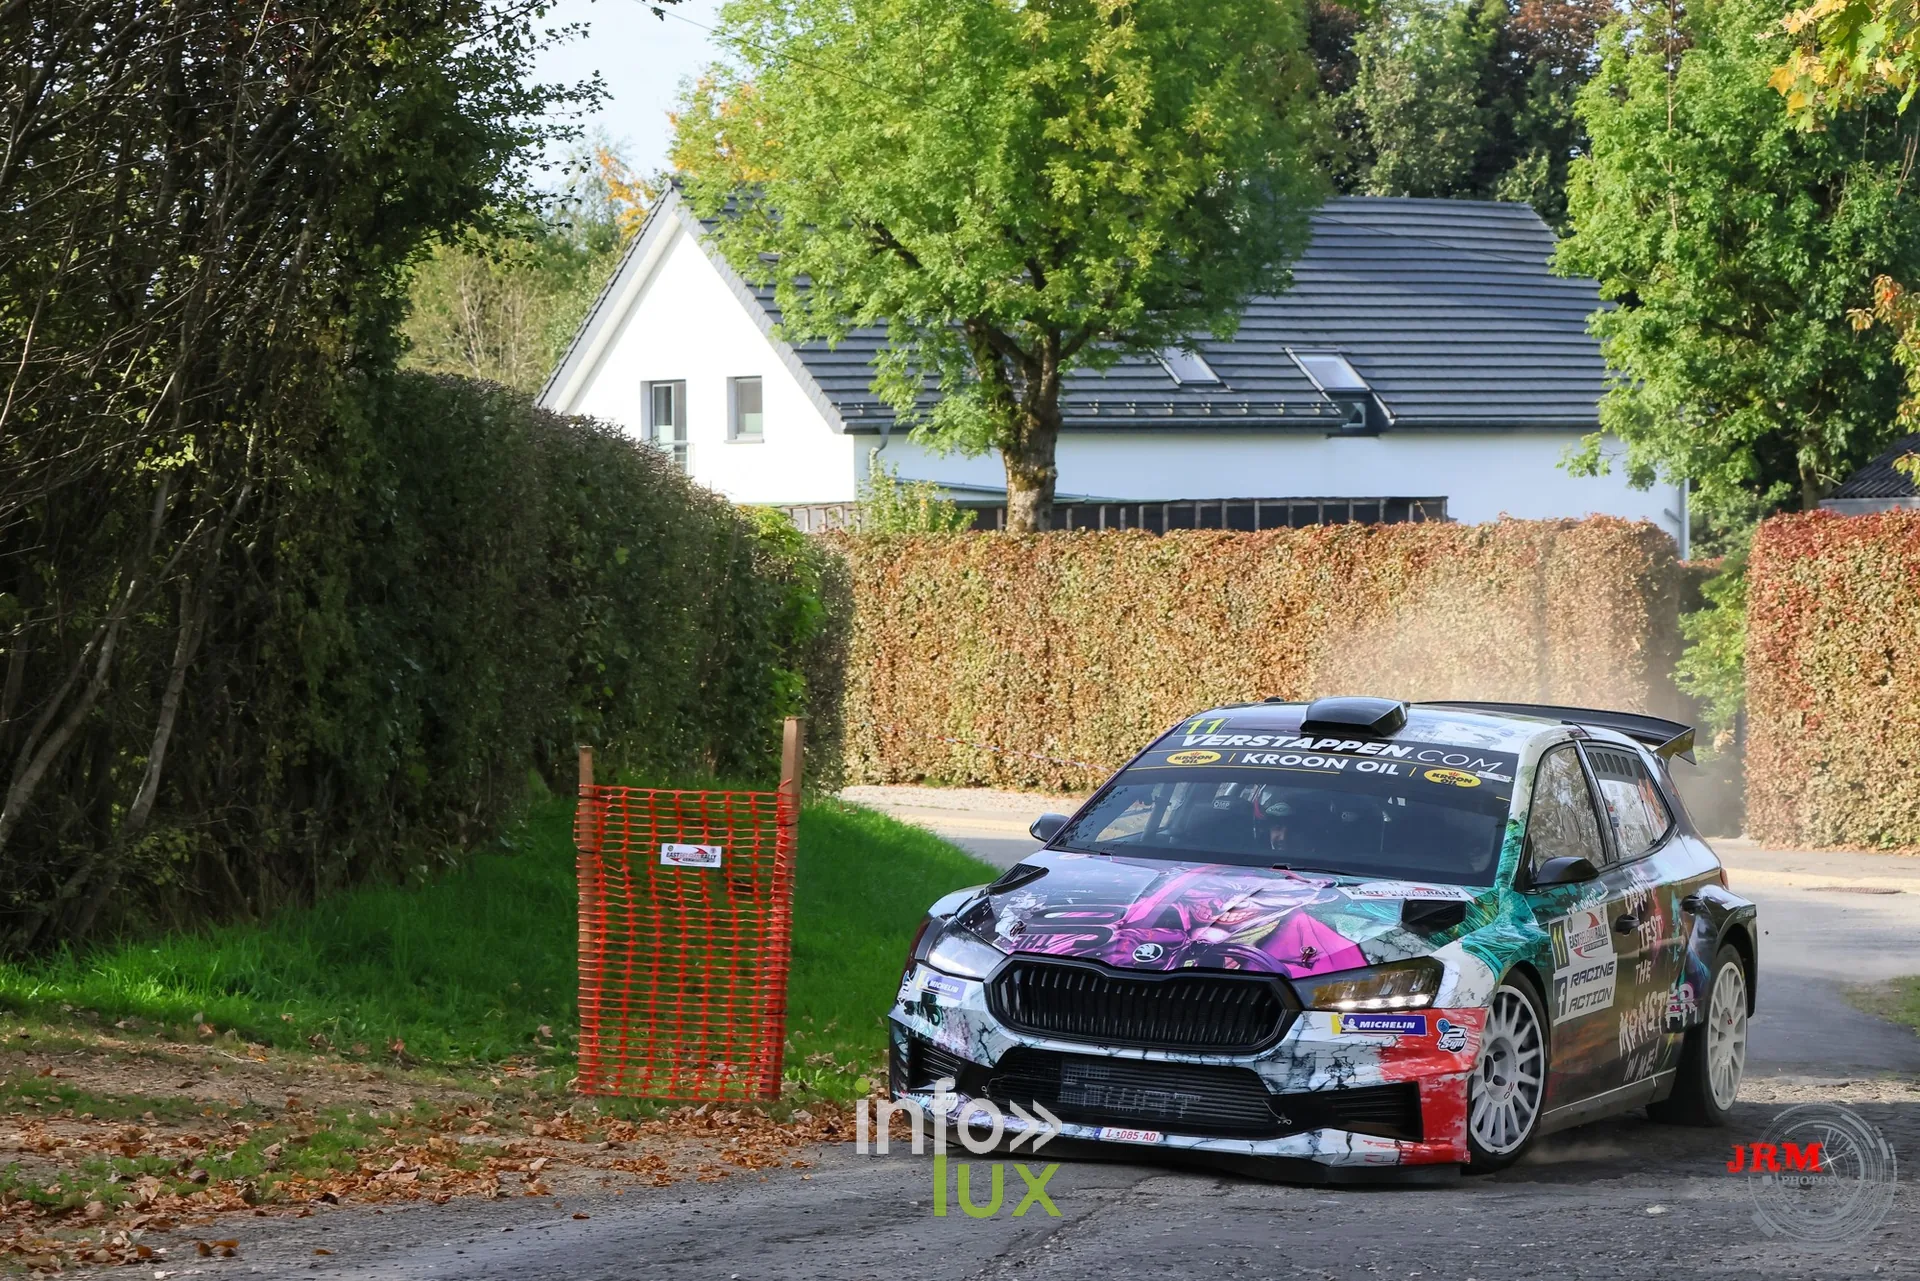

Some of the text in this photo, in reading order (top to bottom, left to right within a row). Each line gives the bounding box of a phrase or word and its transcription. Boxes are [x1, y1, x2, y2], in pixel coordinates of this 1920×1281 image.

[1186, 719, 1225, 734] 11
[1181, 734, 1503, 772] VERSTAPPEN.COM
[1241, 753, 1400, 776] KROON OIL
[1431, 772, 1473, 784] KROON
[1553, 925, 1567, 966] 11
[1638, 915, 1662, 951] TEST
[1570, 961, 1614, 986] RACING
[1635, 959, 1651, 985] THE
[929, 980, 959, 992] MICHELIN
[1568, 987, 1612, 1012] ACTION
[1360, 1021, 1416, 1029] MICHELIN
[1619, 984, 1699, 1058] MONSTER
